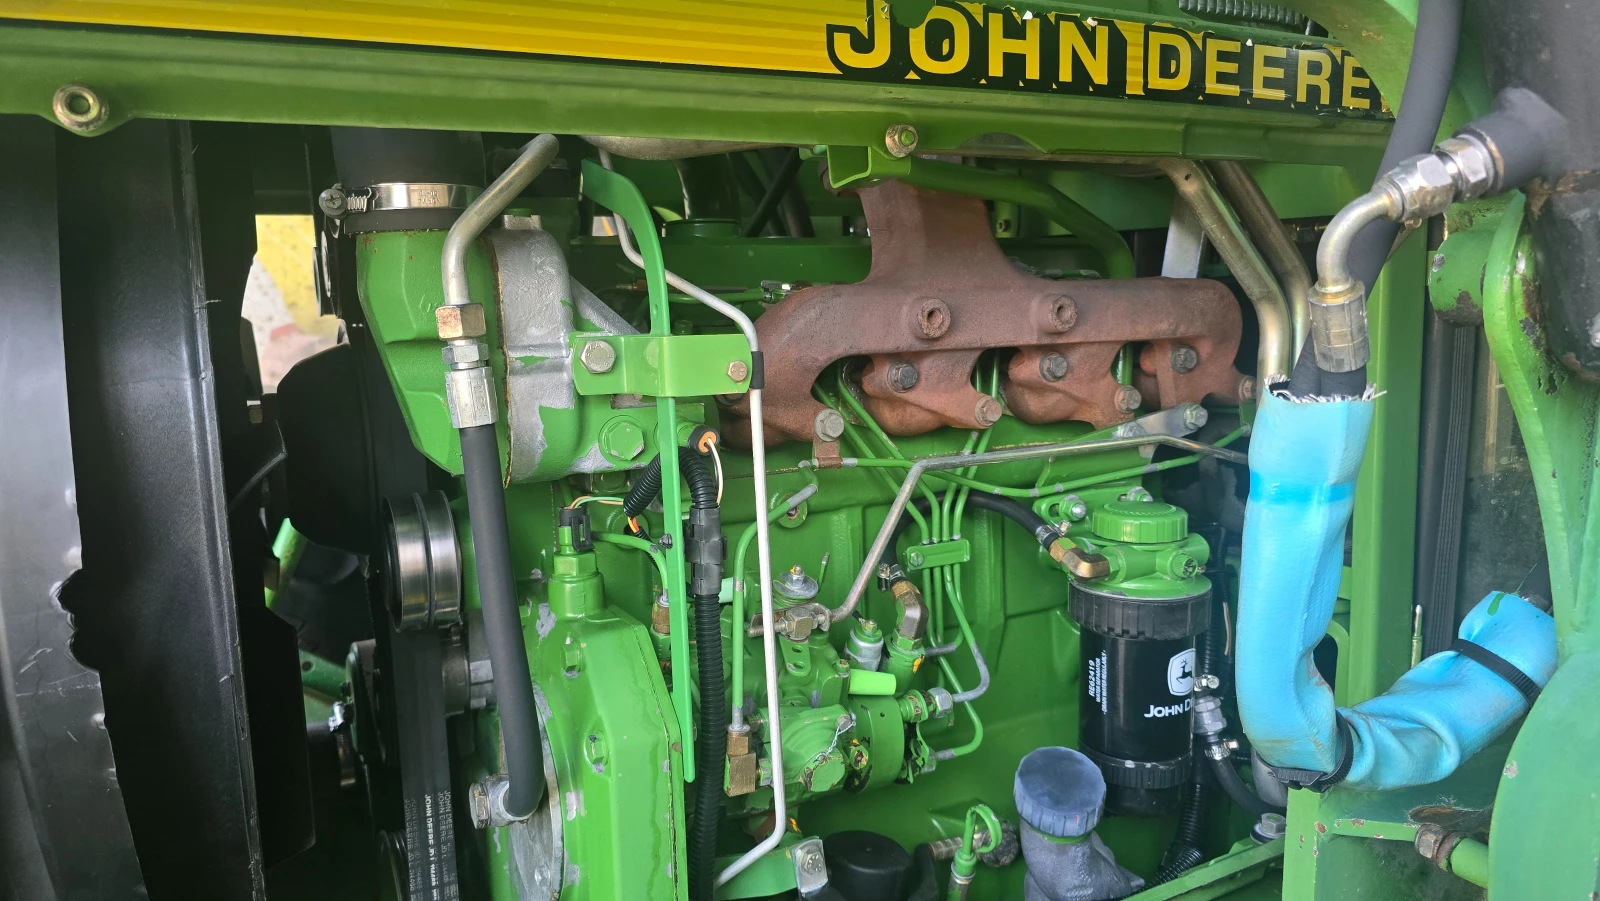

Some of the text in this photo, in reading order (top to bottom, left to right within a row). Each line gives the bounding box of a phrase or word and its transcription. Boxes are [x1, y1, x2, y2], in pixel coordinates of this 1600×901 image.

[834, 0, 1370, 109] JOHN DEERE
[1144, 704, 1183, 718] JOHN
[426, 818, 434, 845] DEERE
